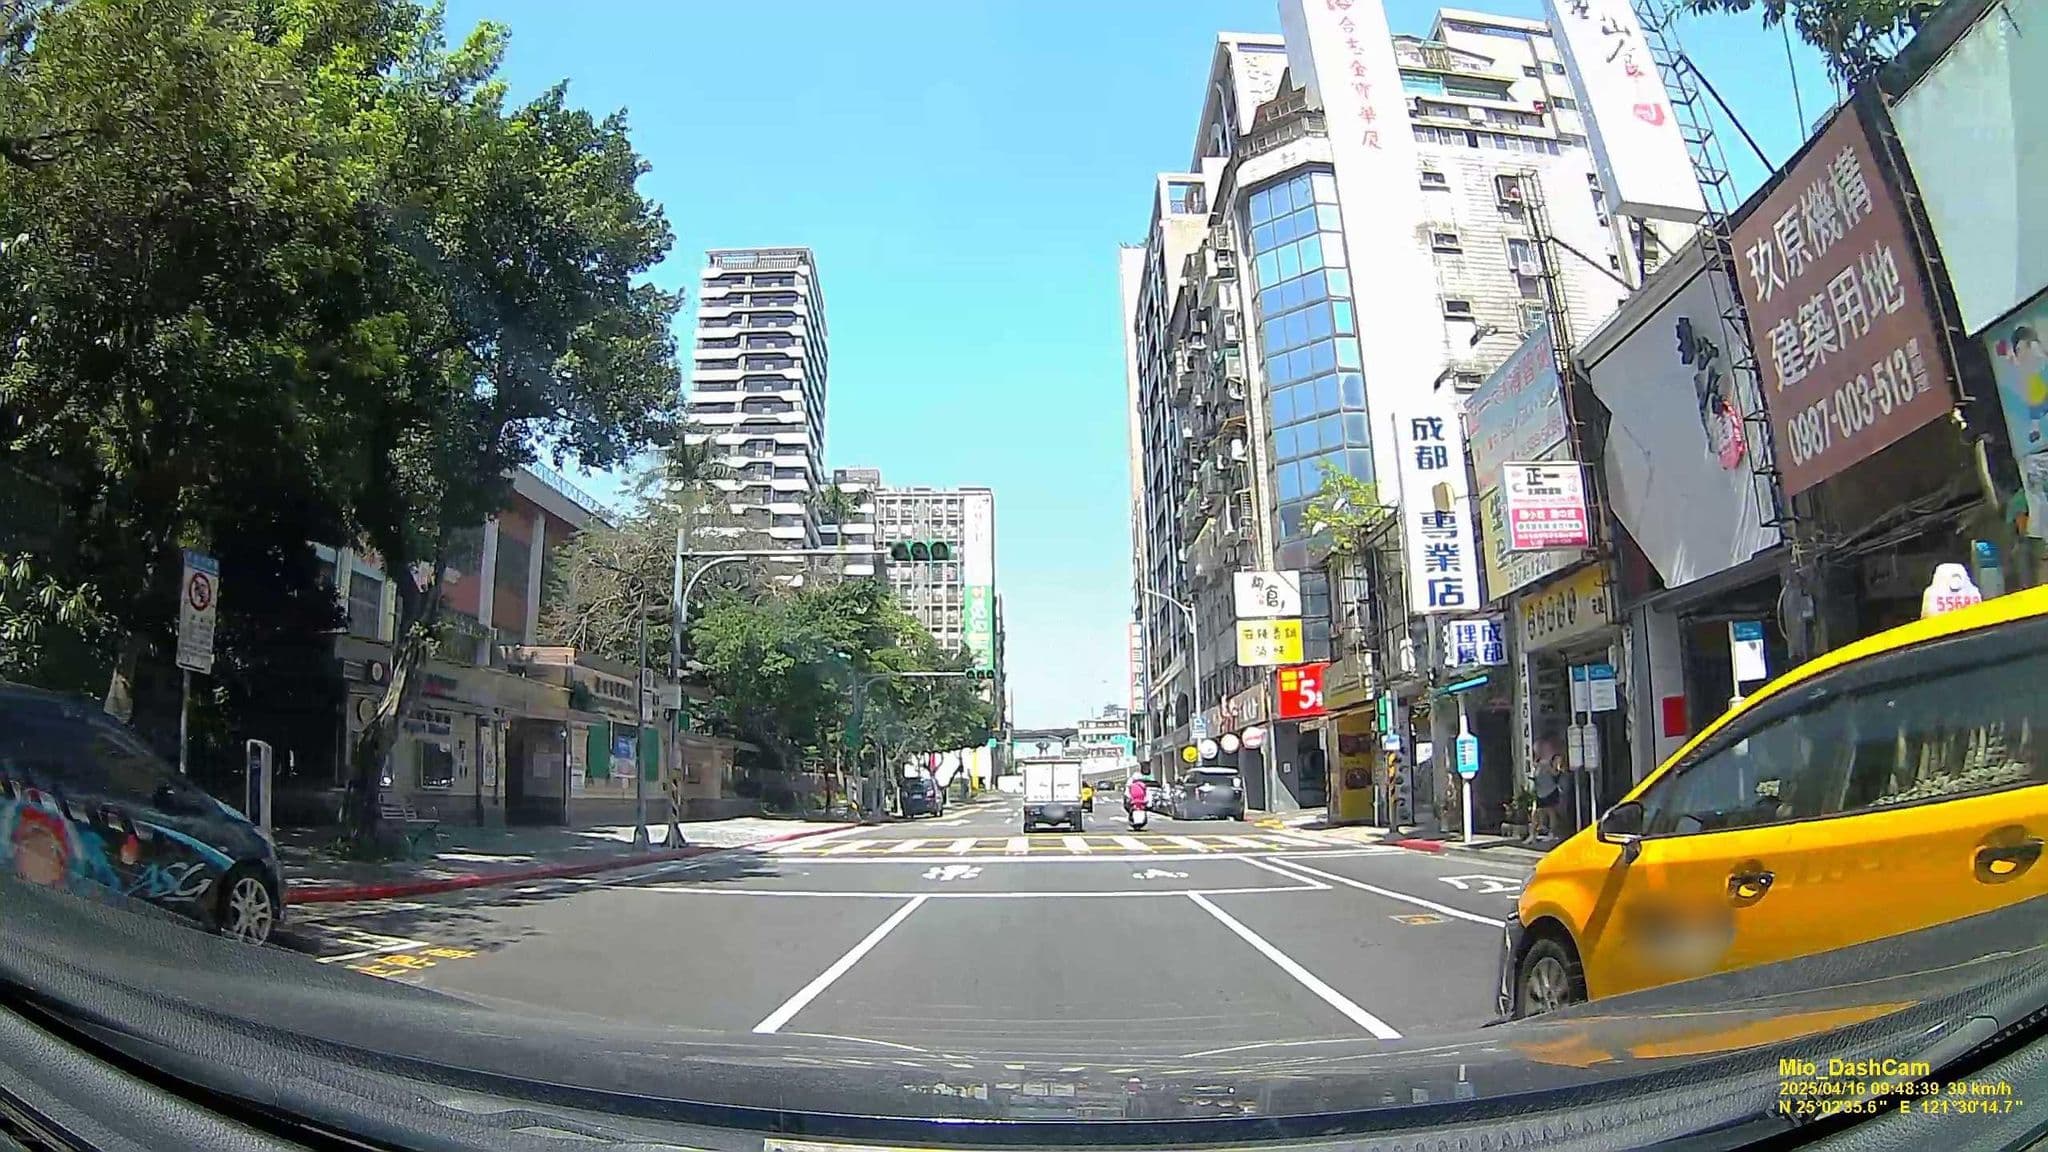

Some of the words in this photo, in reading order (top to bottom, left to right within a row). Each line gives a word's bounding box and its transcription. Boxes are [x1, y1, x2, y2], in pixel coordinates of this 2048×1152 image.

[1746, 146, 1872, 303] 玖原機構
[1766, 240, 1905, 393] 建築用地
[1411, 416, 1449, 471] 成都
[1786, 347, 1916, 466] 0987-003-513
[1419, 510, 1465, 607] 專業店
